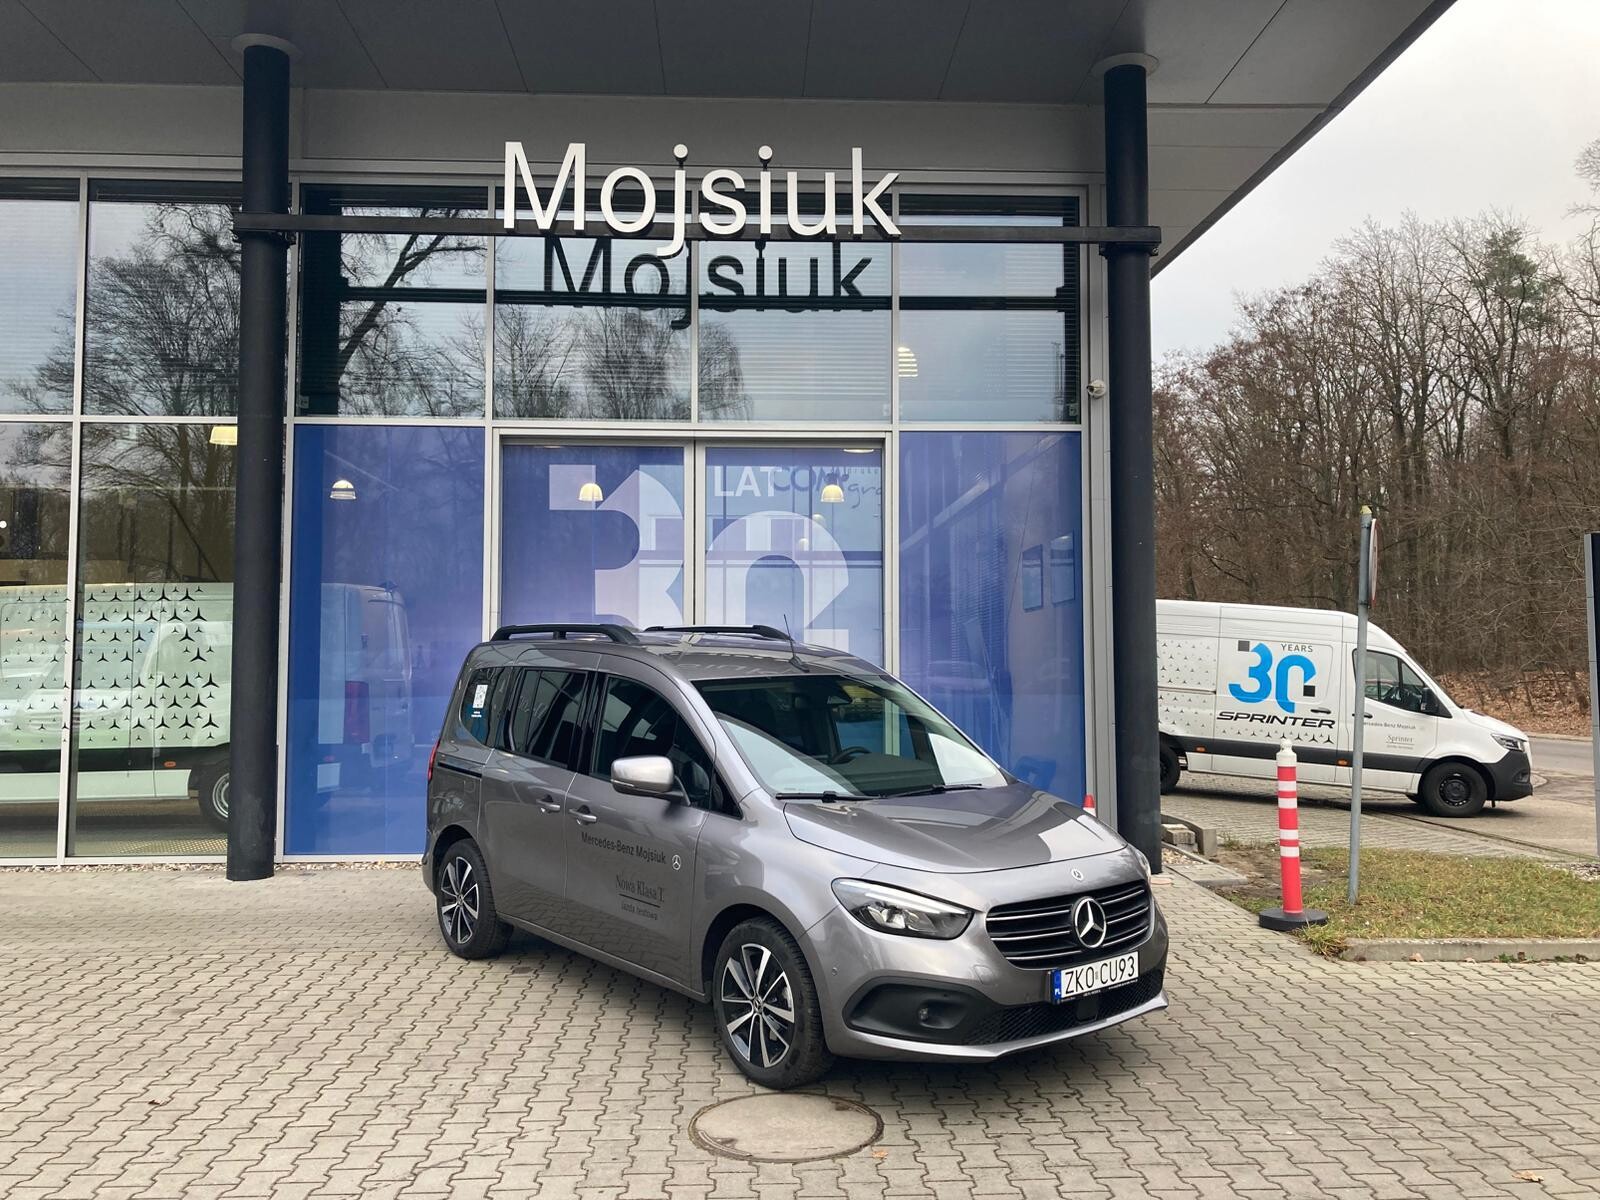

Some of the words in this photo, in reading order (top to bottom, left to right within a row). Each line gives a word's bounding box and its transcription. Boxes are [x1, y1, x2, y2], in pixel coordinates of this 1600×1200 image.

[503, 140, 902, 258] Mojsiuk
[1281, 643, 1314, 653] YEARS
[1216, 711, 1336, 729] SPRINTER
[581, 831, 635, 856] Mercedes-Benz
[635, 845, 667, 864] Mojsiuk
[1065, 966, 1095, 995] ZKO
[1100, 956, 1136, 985] CU93
